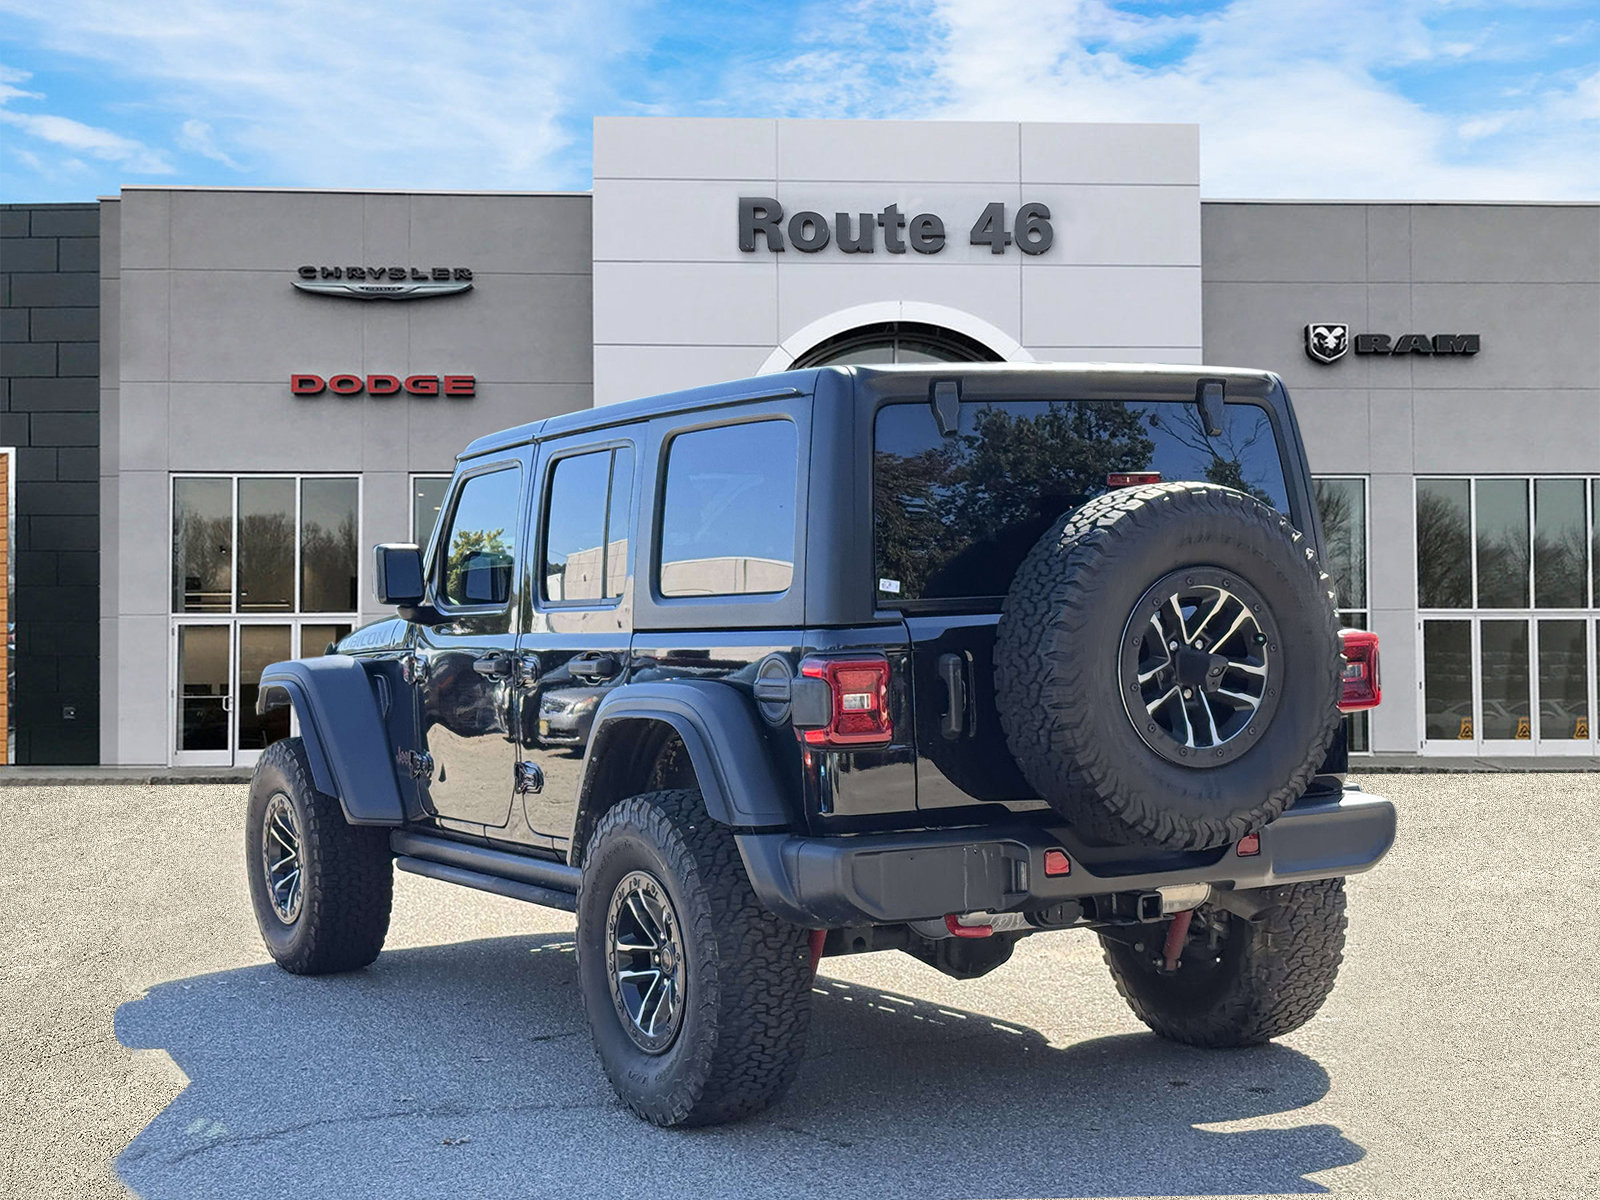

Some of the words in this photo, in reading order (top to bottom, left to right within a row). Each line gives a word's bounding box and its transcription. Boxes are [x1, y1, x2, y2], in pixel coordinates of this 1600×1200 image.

[738, 196, 946, 255] Route
[969, 201, 1054, 255] 46
[297, 265, 474, 281] CHRYSLER
[1355, 333, 1481, 356] RAM
[291, 373, 476, 397] DODGE
